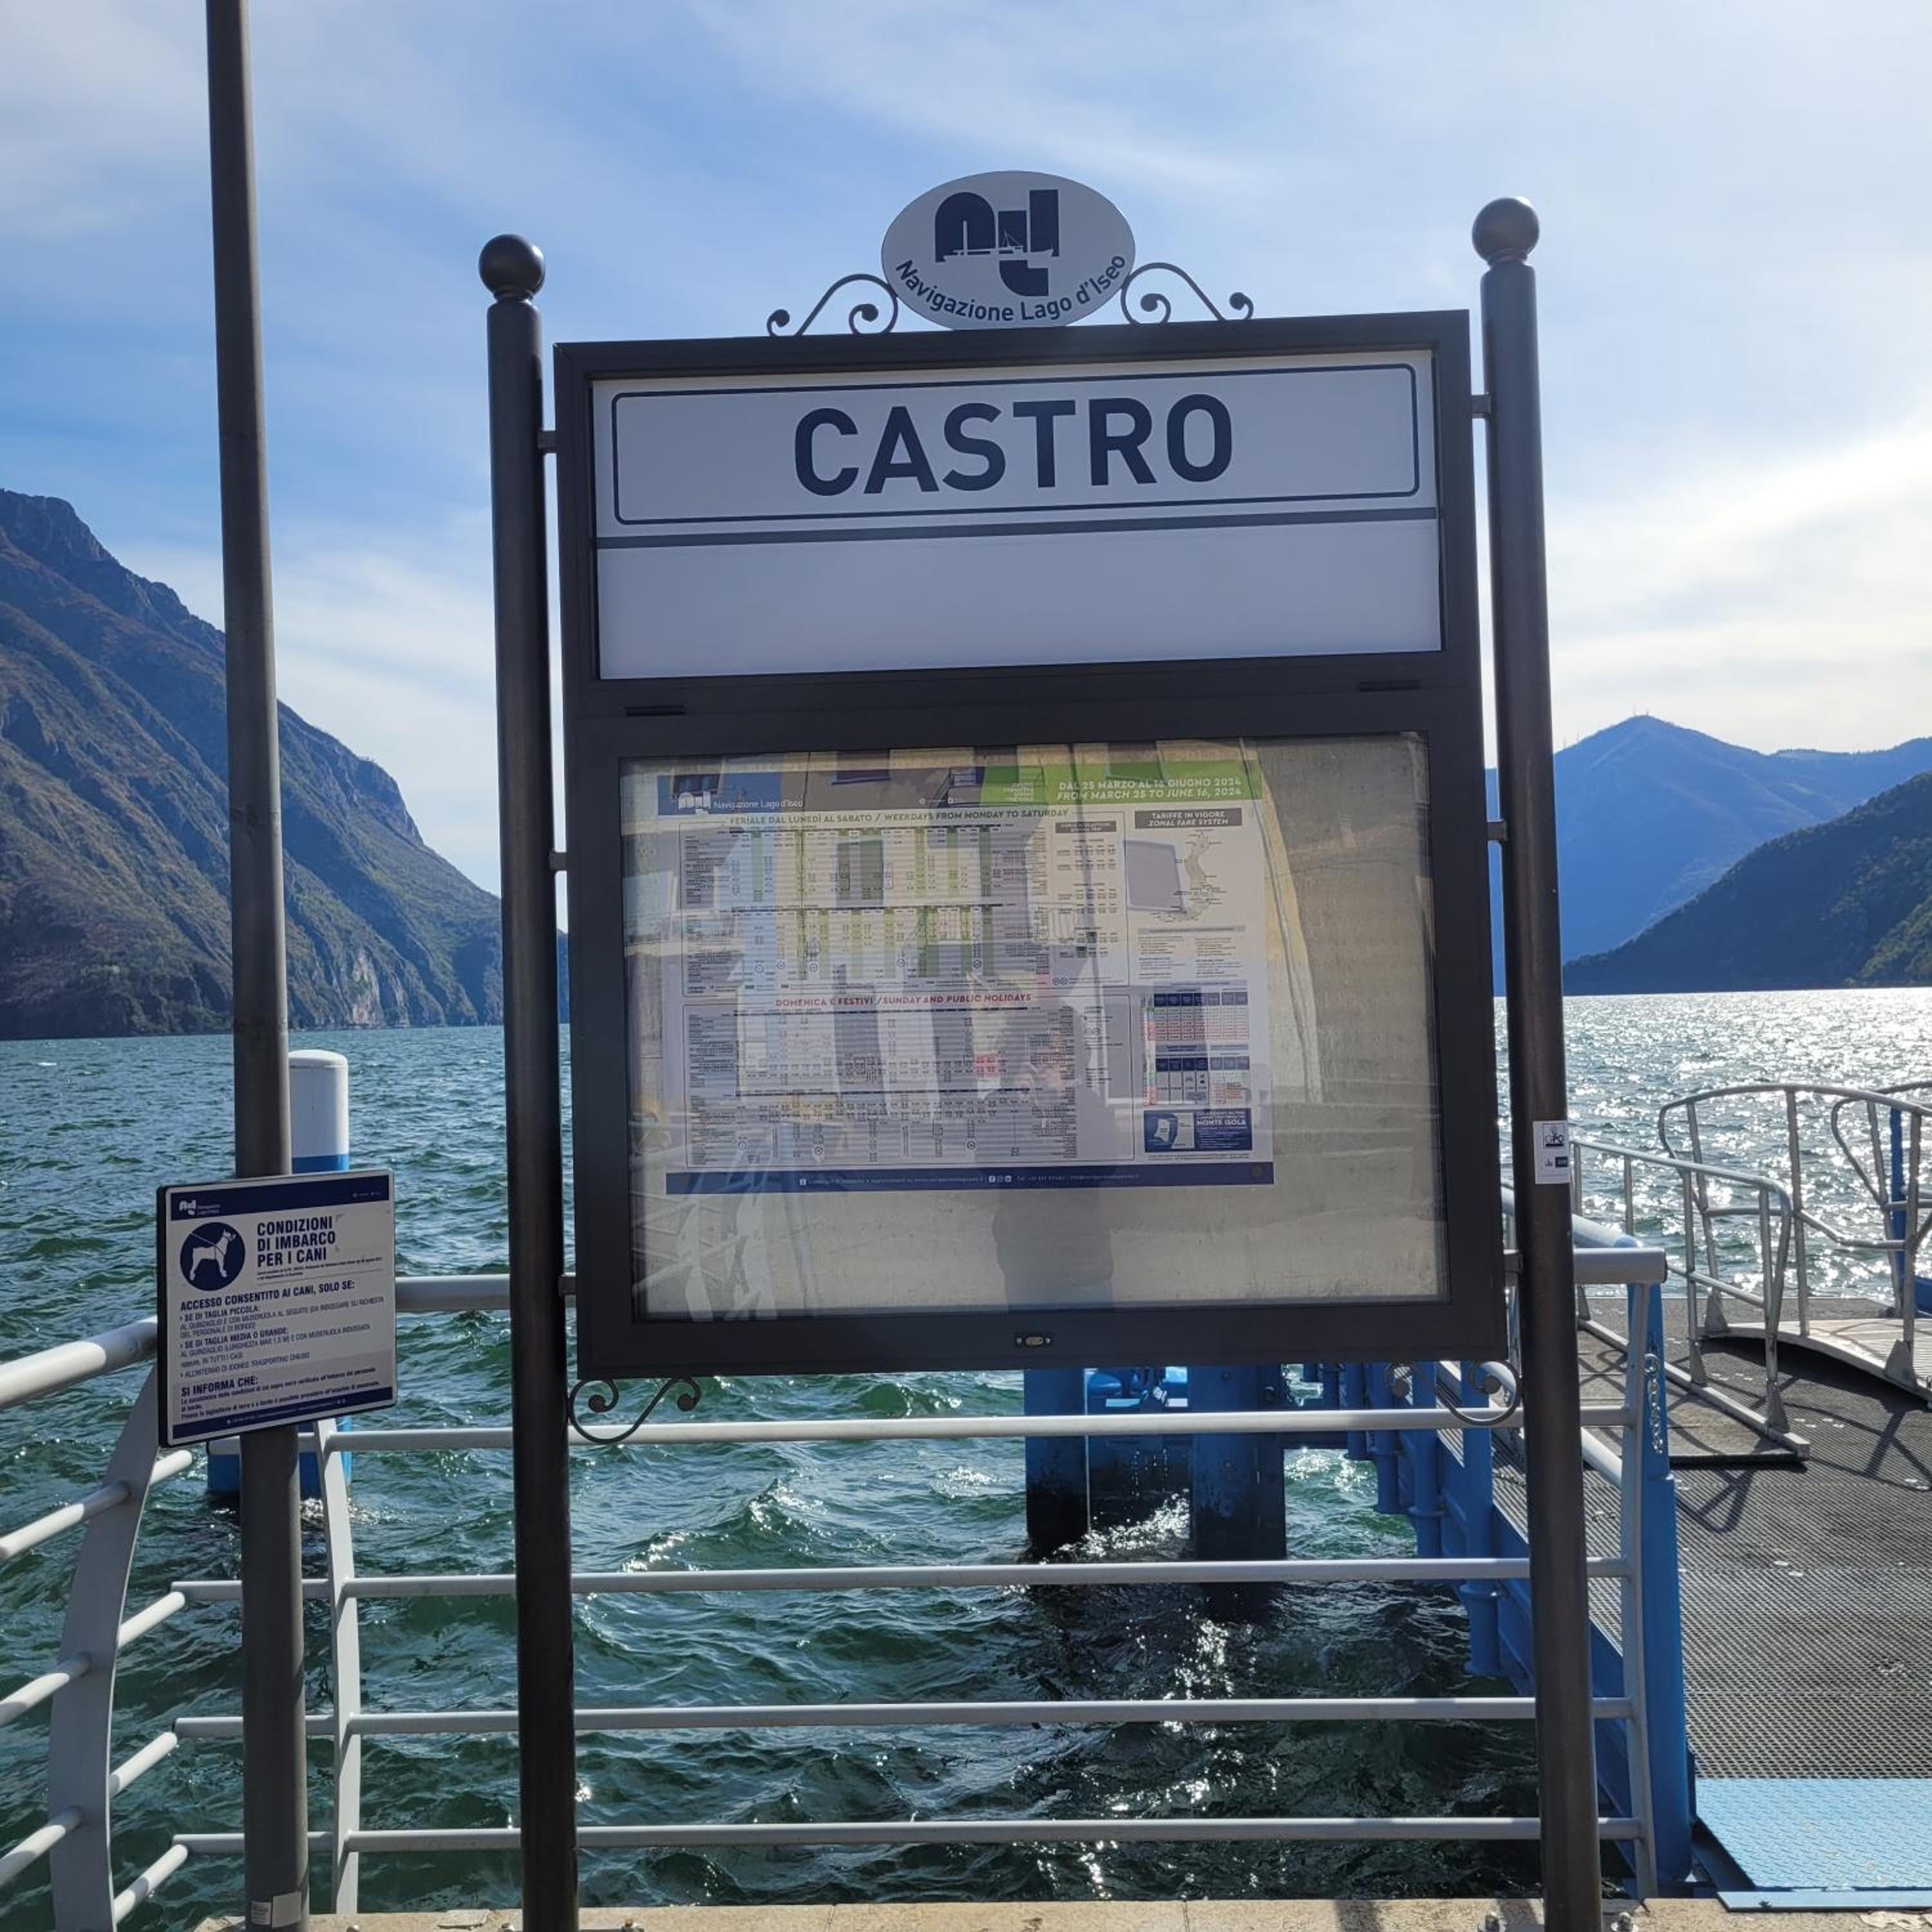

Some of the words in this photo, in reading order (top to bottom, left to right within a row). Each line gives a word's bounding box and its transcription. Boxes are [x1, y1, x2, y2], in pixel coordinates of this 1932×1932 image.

[896, 259, 1014, 322] Navigazione
[1020, 296, 1072, 321] Lago
[1075, 254, 1126, 305] d'Iseo
[794, 393, 1232, 497] CASTRO
[1057, 791, 1087, 800] FROM
[1090, 790, 1130, 800] MARCH
[1133, 790, 1146, 799] 25
[1150, 789, 1164, 798] TO
[1167, 788, 1195, 798] JUNE
[1215, 786, 1242, 796] 2024
[1081, 781, 1095, 790] 25
[1097, 780, 1135, 790] MARZO
[1168, 778, 1211, 788] GIUGNO
[1214, 777, 1242, 786] 2024
[730, 815, 766, 824] FERIALE
[768, 815, 786, 824] DAL
[788, 813, 822, 823] LUNEDÌ
[824, 814, 835, 823] AL
[837, 814, 873, 823] SABATO
[884, 811, 933, 822] WEEKDAYS
[935, 811, 962, 820] FROM
[965, 810, 1006, 820] MONDAY
[1007, 810, 1019, 819] TO
[1021, 808, 1070, 817] SATURDAY
[775, 998, 828, 1008] DOMENICA
[837, 996, 873, 1006] FESTIVI
[920, 995, 943, 1004] AND
[945, 994, 982, 1003] PUBLIC
[983, 993, 1032, 1003] HOLIDAYS
[258, 1215, 333, 1236] CONDIZIONI
[258, 1237, 270, 1252] DI
[275, 1231, 336, 1250] IMBARCO
[258, 1253, 283, 1267] PER
[288, 1251, 292, 1264] I
[296, 1247, 327, 1263] CANI
[180, 1296, 222, 1311] ACCESSO
[225, 1289, 280, 1305] CONSENTITO
[282, 1288, 290, 1298] AI
[293, 1285, 316, 1296] CANI,
[319, 1281, 340, 1293] SOLO
[342, 1280, 355, 1290] SE:
[185, 1313, 194, 1321] SE
[205, 1309, 229, 1319] TAGLIA
[185, 1340, 194, 1349] SE
[195, 1339, 203, 1348] DI
[205, 1336, 229, 1347] TAGLIA
[230, 1332, 252, 1342] MEDIA
[181, 1387, 191, 1397] SI
[193, 1379, 235, 1395] INFORMA
[238, 1375, 258, 1387] CHE:
